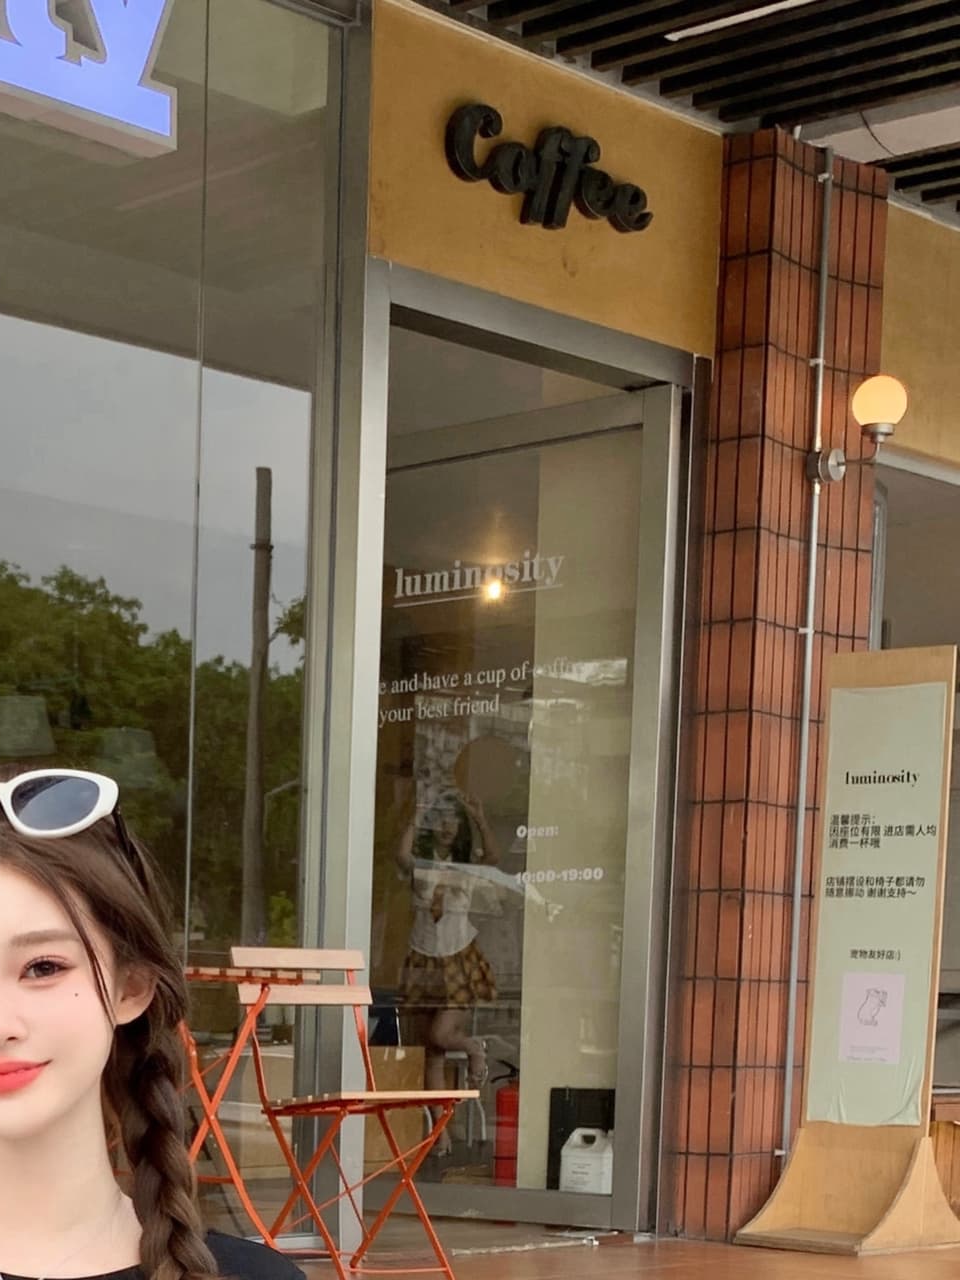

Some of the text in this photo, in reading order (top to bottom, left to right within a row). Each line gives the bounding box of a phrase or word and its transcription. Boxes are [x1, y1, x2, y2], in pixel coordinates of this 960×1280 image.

[445, 104, 653, 232] Coffee
[394, 549, 565, 599] luminosity
[391, 673, 418, 694] and
[423, 671, 459, 690] have
[464, 673, 472, 686] a
[477, 668, 507, 688] cup
[511, 660, 529, 681] of
[378, 693, 500, 728] your best friend
[845, 769, 920, 788] luminosity
[516, 825, 559, 838] Open:
[516, 867, 604, 884] 10:00-19:00
